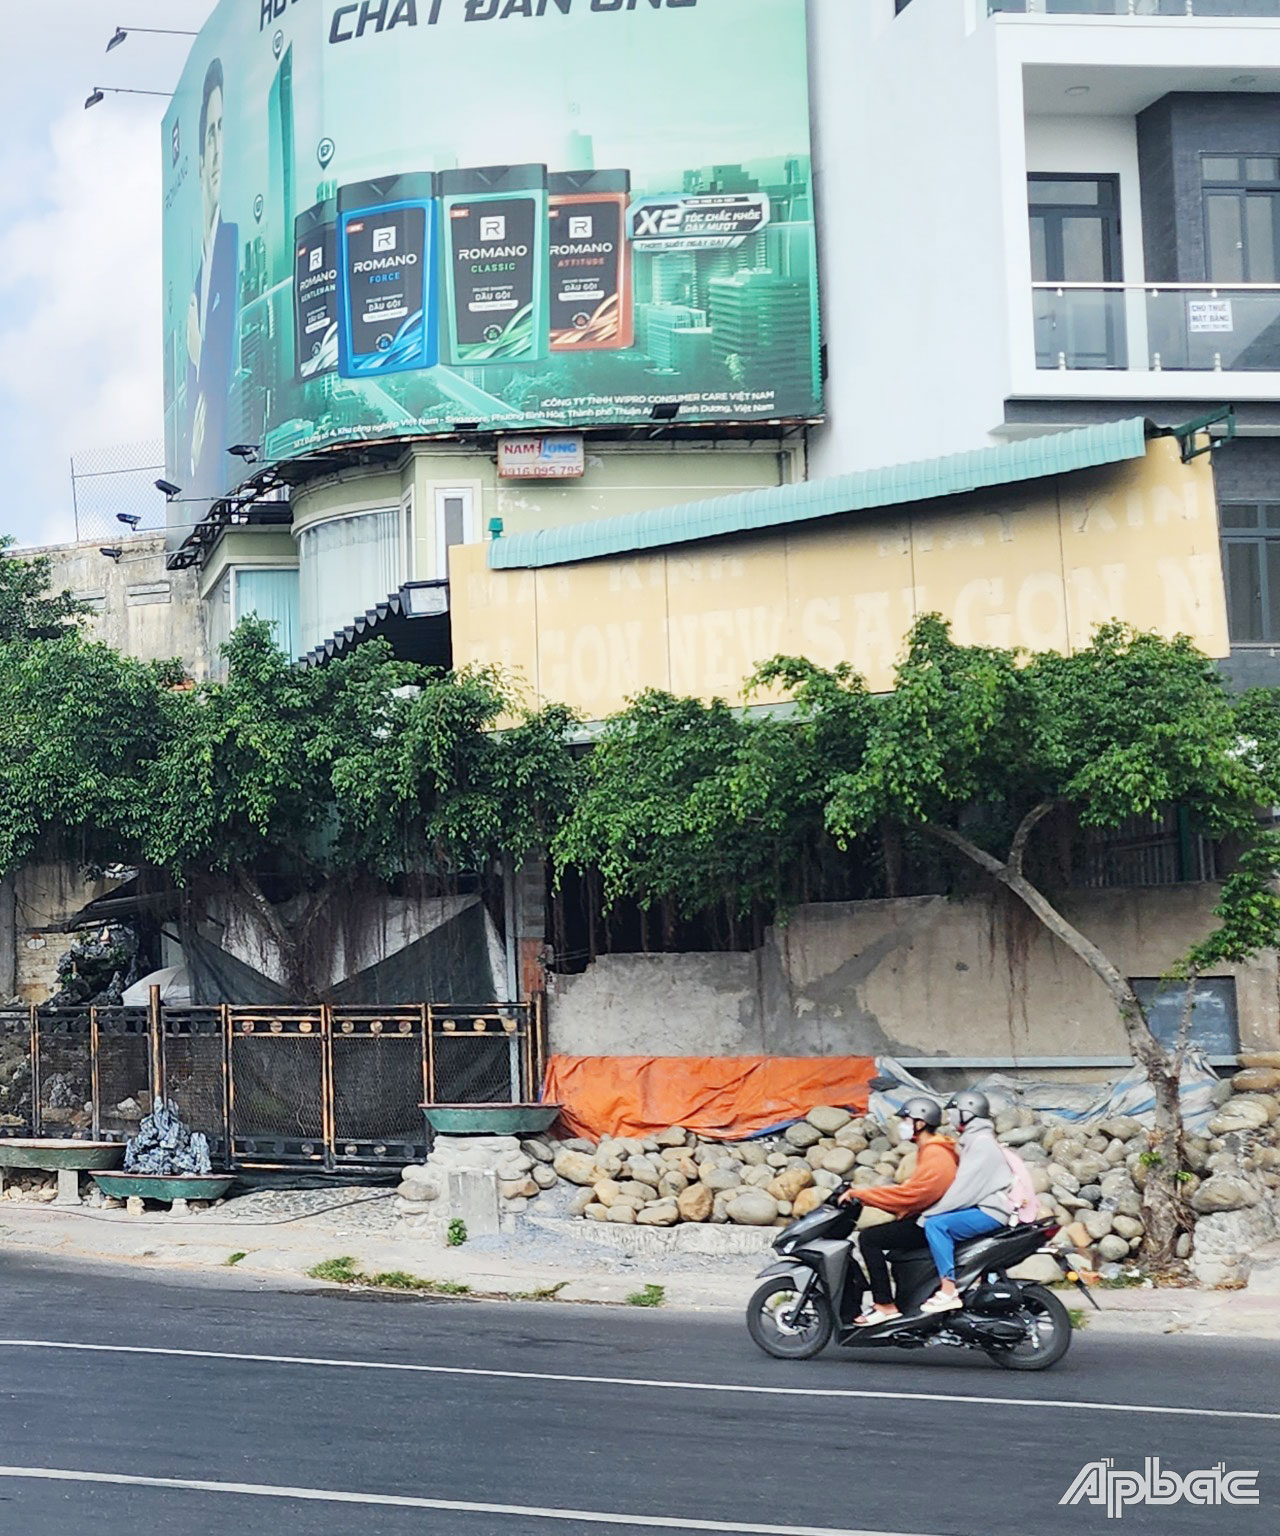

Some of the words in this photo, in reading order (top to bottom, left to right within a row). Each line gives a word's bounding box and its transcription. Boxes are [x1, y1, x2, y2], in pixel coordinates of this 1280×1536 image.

[635, 208, 682, 235] X2
[458, 245, 528, 261] ROMANO
[549, 242, 613, 256] ROMANO
[353, 253, 418, 274] ROMANO
[471, 262, 516, 273] CLASSIC
[557, 257, 605, 268] ATTITUDE
[299, 269, 337, 292] ROMANO
[369, 272, 401, 284] FORCE
[573, 397, 587, 406] TY
[587, 396, 613, 405] TNHH
[613, 395, 646, 404] WIPRO
[647, 392, 700, 403] CONSUMER
[701, 392, 728, 401] CARE
[729, 391, 751, 401] VIỆT
[751, 390, 775, 400] NAM
[418, 417, 439, 426] Nam
[753, 403, 775, 411] Nam
[504, 443, 535, 455] NAM
